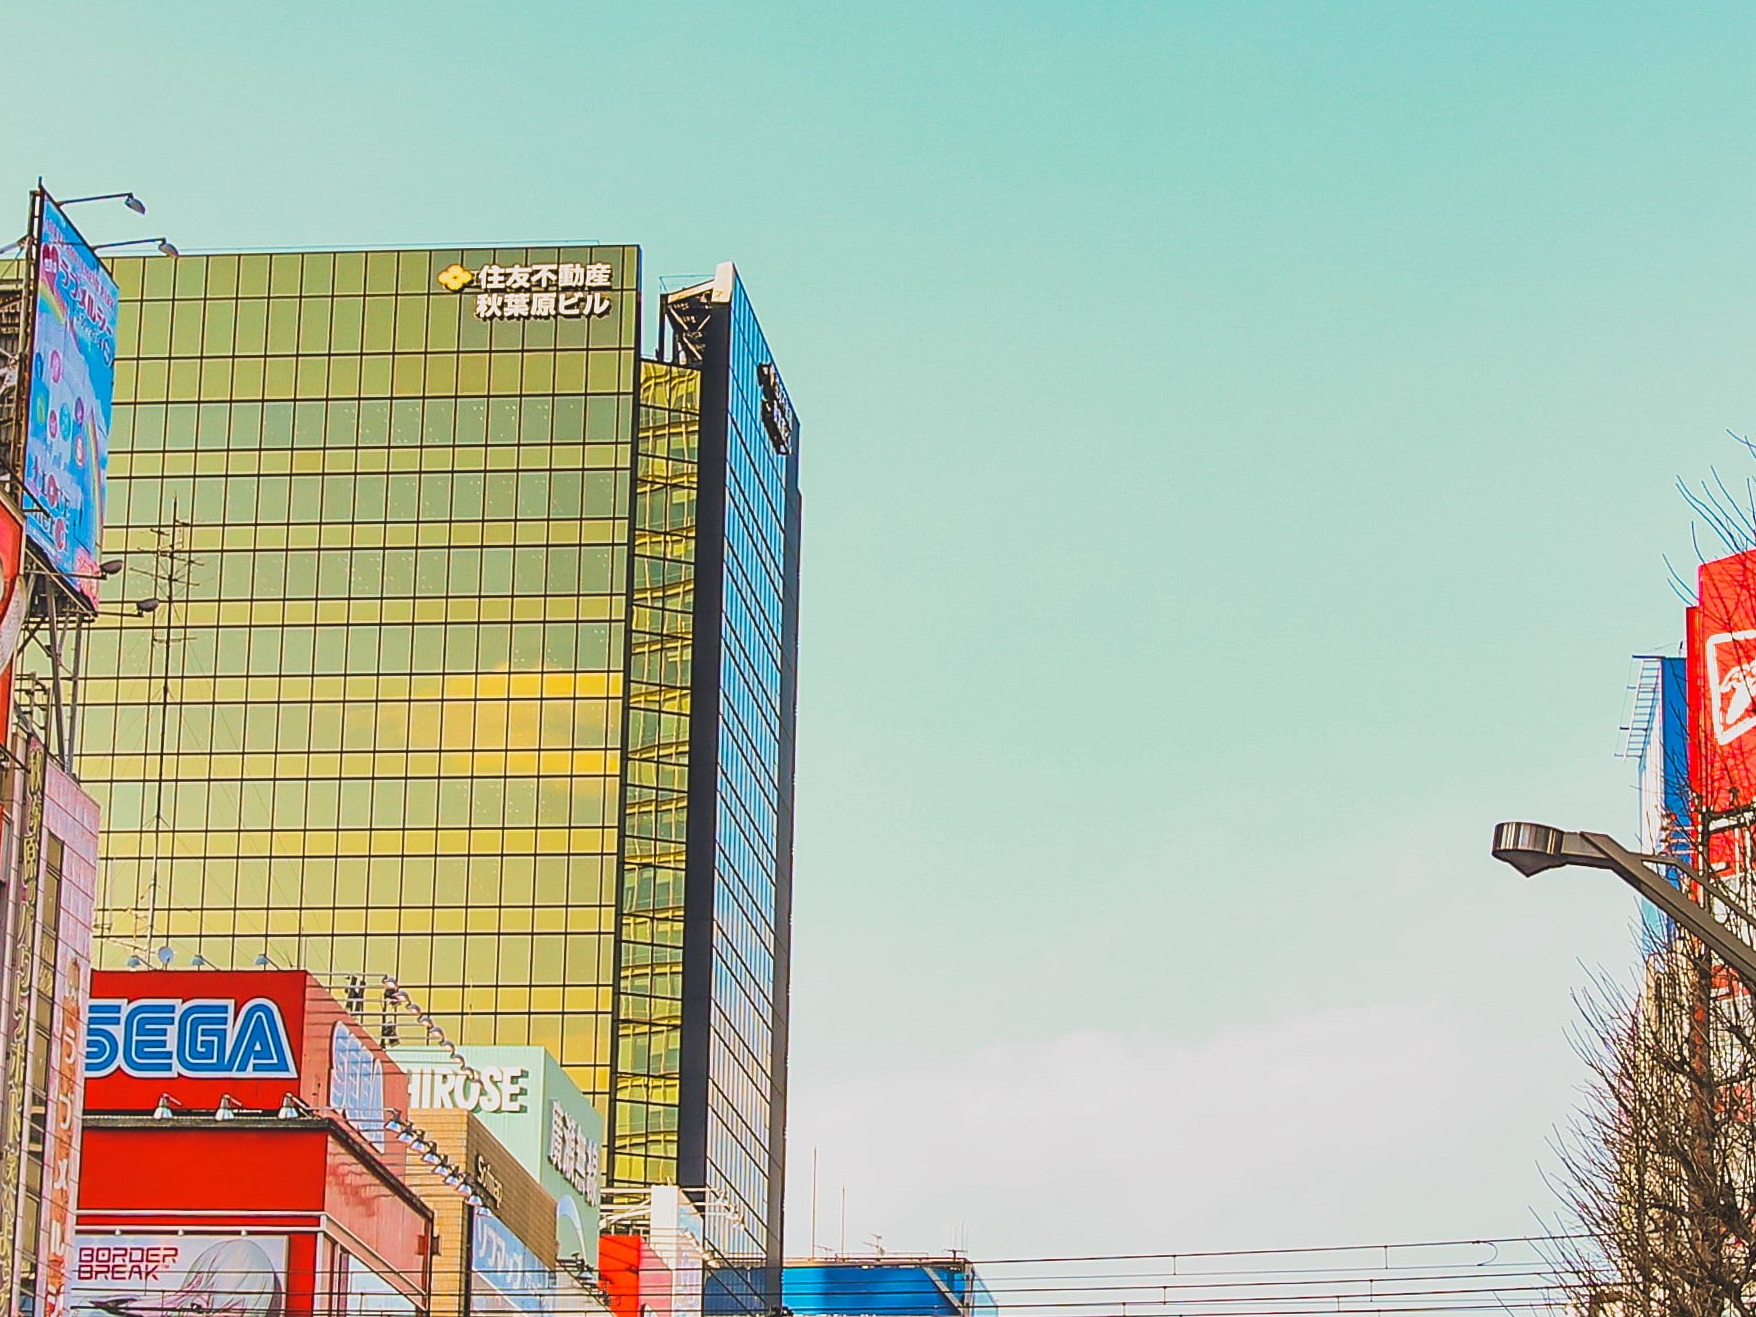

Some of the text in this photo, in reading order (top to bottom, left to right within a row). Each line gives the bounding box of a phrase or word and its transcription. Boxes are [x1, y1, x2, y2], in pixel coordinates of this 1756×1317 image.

[478, 262, 614, 292] 住友不動産
[474, 291, 611, 320] 秋葉原ビル
[83, 998, 298, 1079] SEGA
[78, 1247, 179, 1265] BORDER
[77, 1263, 160, 1281] BREAK
